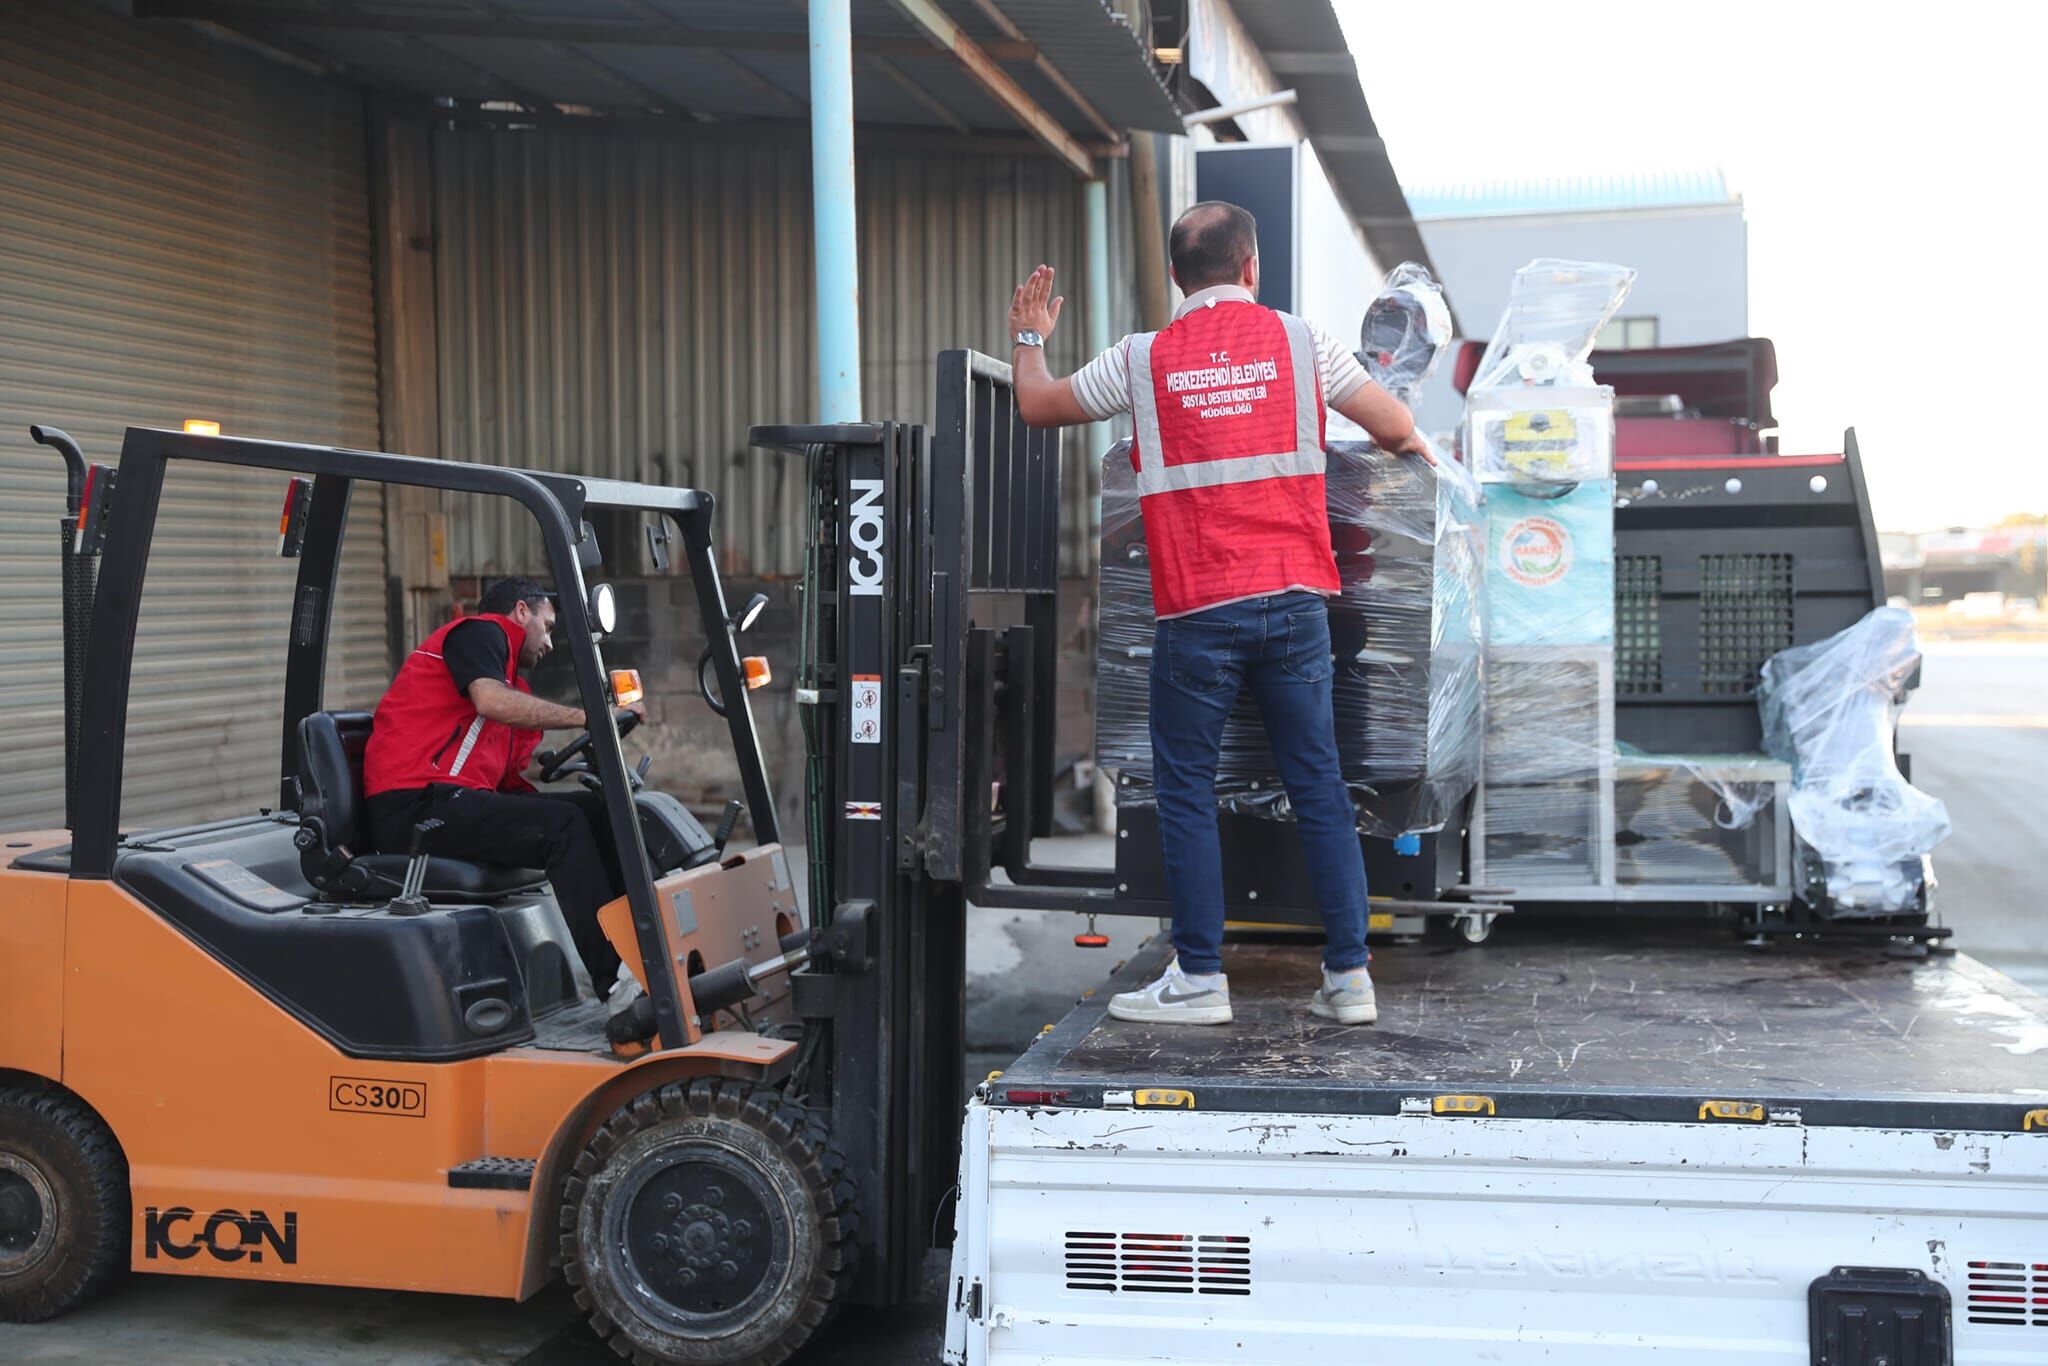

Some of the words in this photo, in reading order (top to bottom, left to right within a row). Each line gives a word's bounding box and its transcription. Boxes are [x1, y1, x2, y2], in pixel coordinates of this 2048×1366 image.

[1209, 351, 1231, 363] T.C.
[1166, 362, 1230, 392] MERKEZEFENDİ
[1230, 357, 1278, 383] BELEDİYESİ
[1182, 392, 1207, 408] SOSYAL
[1207, 389, 1233, 405] DESTEK
[1231, 384, 1267, 402] HİZMETLERİ
[1200, 403, 1253, 419] MÜDÜRLÜĞÜ
[849, 479, 884, 596] ICON
[335, 1083, 421, 1110] CS30D
[145, 1206, 297, 1264] ICON
